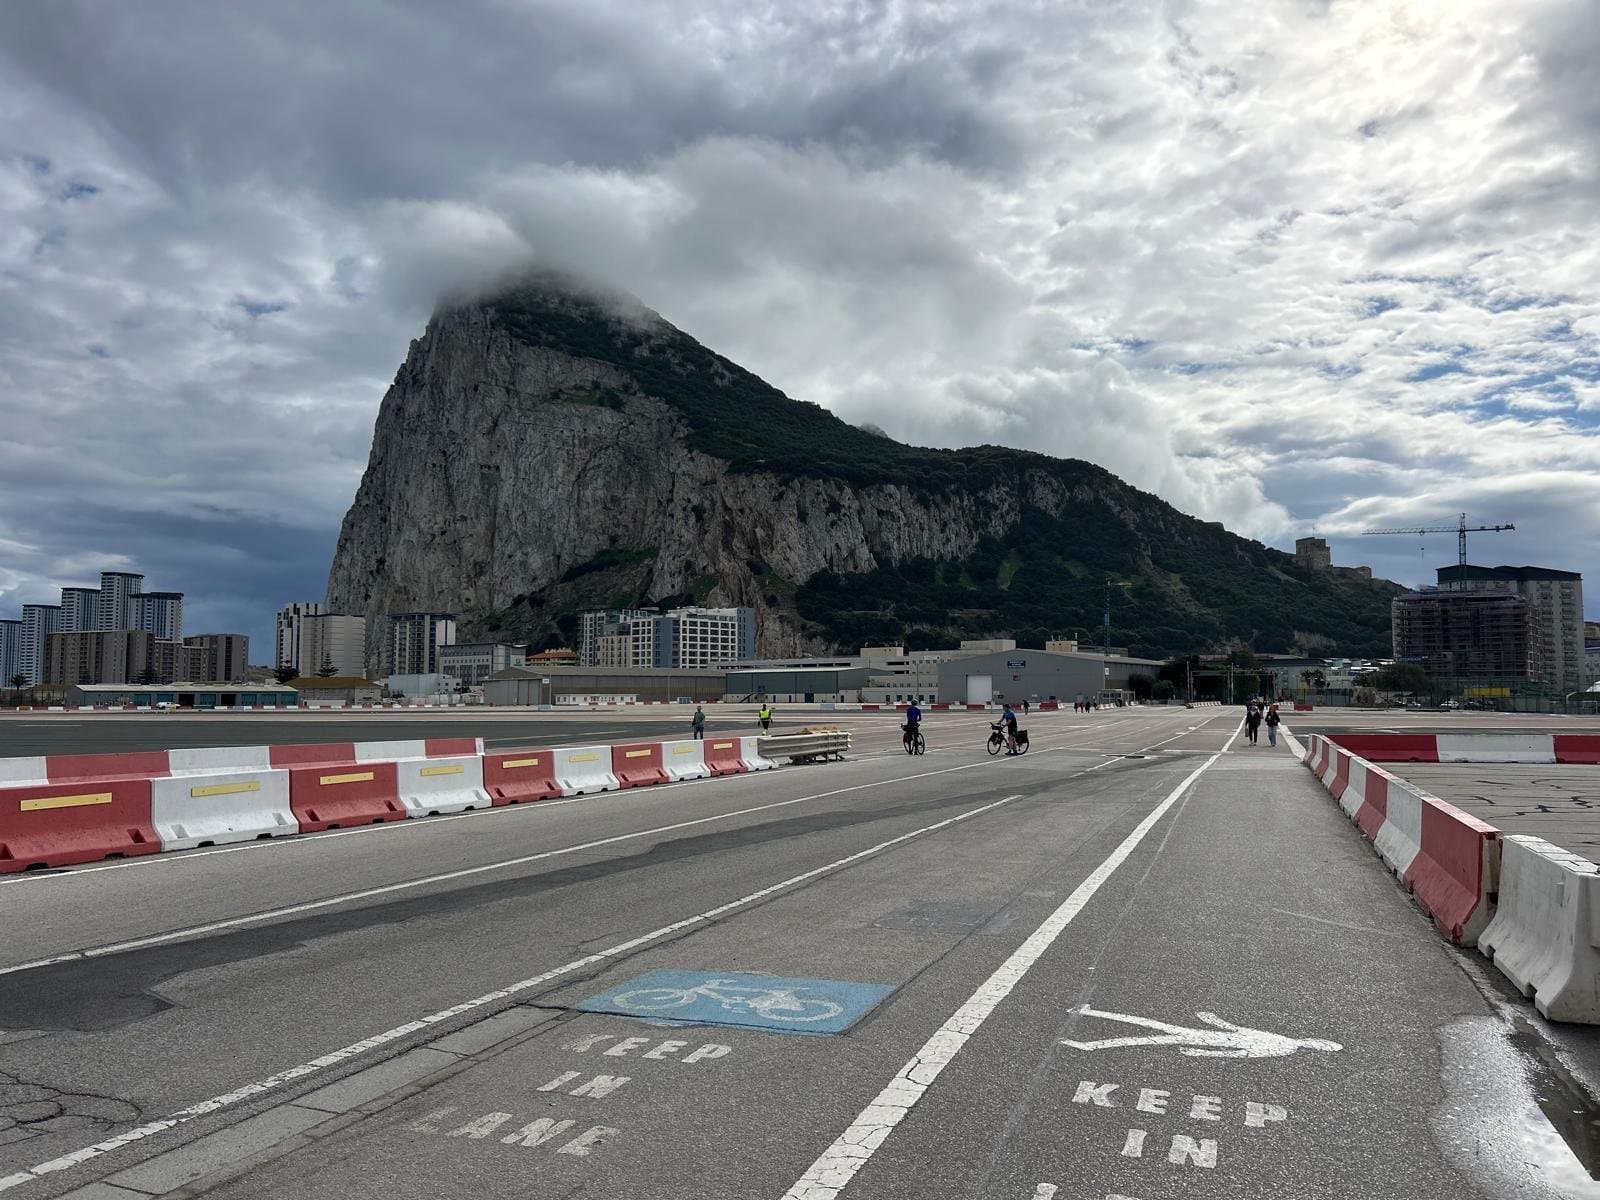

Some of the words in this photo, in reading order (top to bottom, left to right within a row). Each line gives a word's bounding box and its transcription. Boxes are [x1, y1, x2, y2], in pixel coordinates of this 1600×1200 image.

[562, 1034, 732, 1063] KEEP
[536, 1071, 631, 1099] IN
[1072, 1081, 1288, 1128] KEEP
[408, 1106, 621, 1157] LANE
[1121, 1129, 1218, 1169] IN
